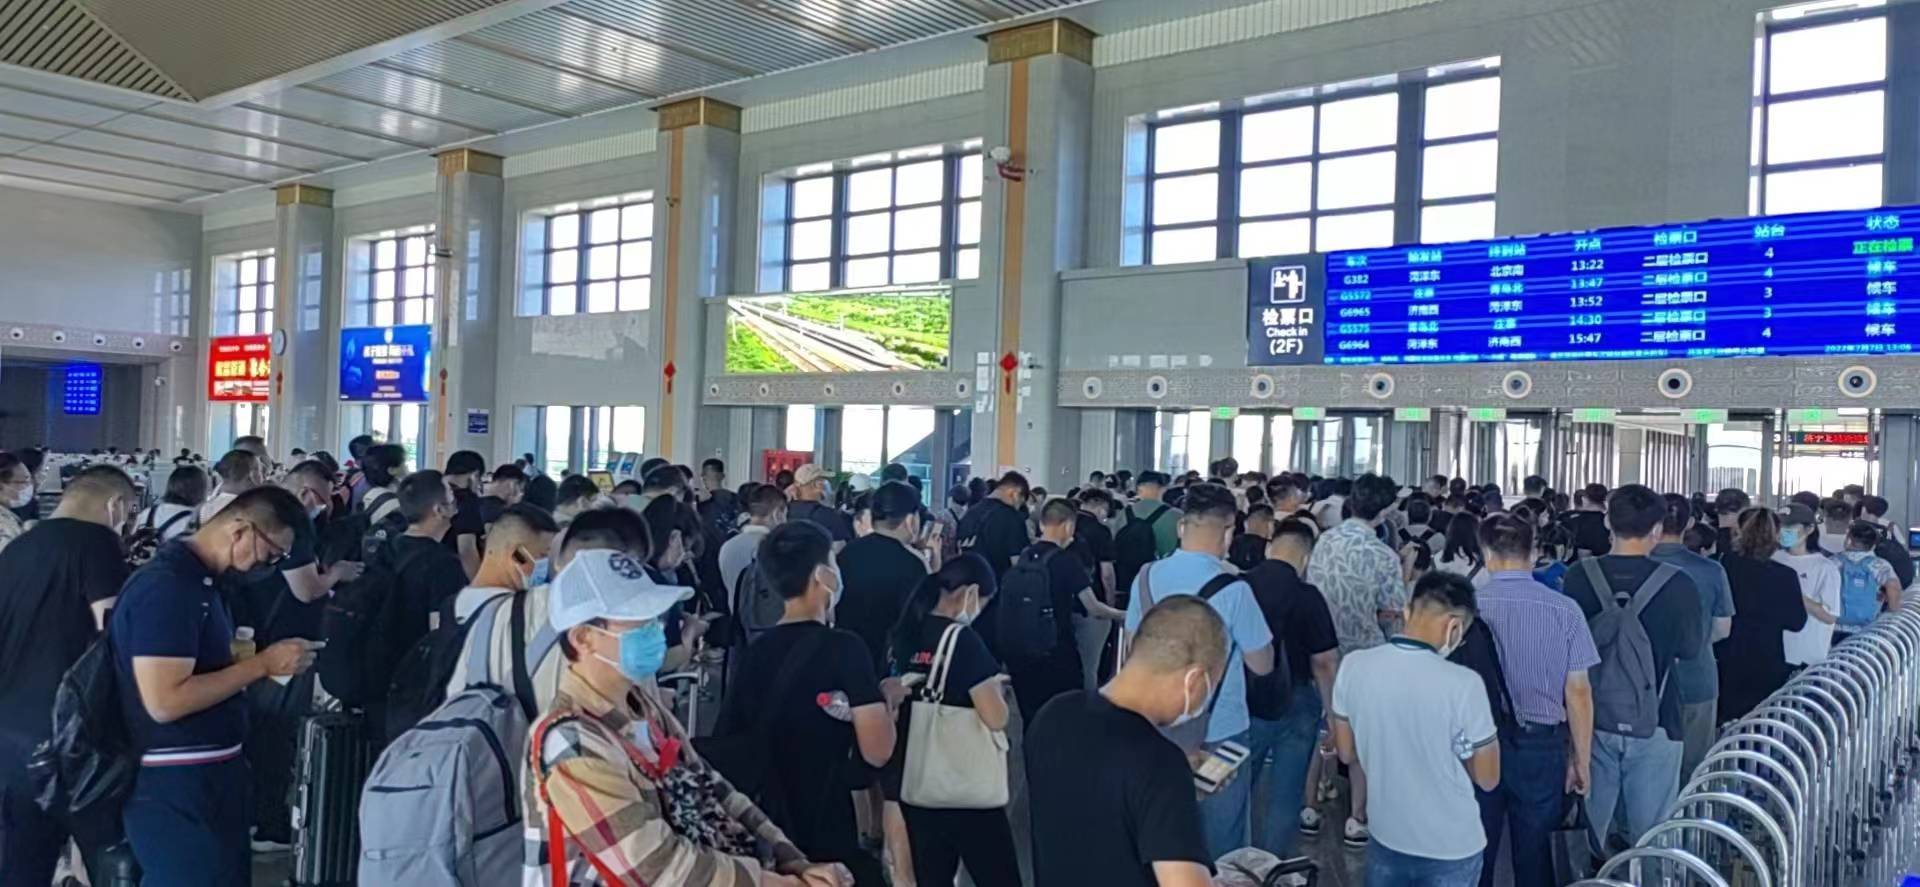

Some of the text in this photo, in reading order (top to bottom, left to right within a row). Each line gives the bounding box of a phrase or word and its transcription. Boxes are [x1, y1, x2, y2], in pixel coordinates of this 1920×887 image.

[1574, 238, 1601, 252] 开点
[1653, 230, 1697, 246] 检票口
[1754, 223, 1786, 239] 站台
[1866, 215, 1900, 230] 状态
[1343, 274, 1369, 285] G382
[1490, 264, 1524, 277] 北京南
[1571, 259, 1604, 271] 13:22
[1642, 252, 1709, 267] 二层检票口
[1764, 247, 1774, 258] 4
[1853, 238, 1914, 254] 正在检票
[1570, 277, 1603, 290] 13:47
[1641, 271, 1708, 286] 二层检票口
[1764, 267, 1773, 278] 4
[1866, 261, 1897, 274] 候车
[1339, 307, 1370, 317] G6965
[1408, 304, 1439, 316] 济南西
[1570, 296, 1603, 307] 13:52
[1641, 290, 1707, 305] 二层检票口
[1763, 287, 1773, 298] 3
[1866, 281, 1897, 295] 候车
[1262, 308, 1314, 326] 检票口
[1569, 315, 1602, 326] 14:30
[1640, 310, 1706, 324] 二层检票口
[1763, 307, 1772, 318] 3
[1866, 302, 1897, 316] 候车
[1266, 327, 1308, 338] Check in
[1338, 341, 1370, 350] G6964
[1488, 335, 1522, 347] 济南西
[1569, 333, 1601, 344] 15:47
[1640, 329, 1706, 343] 二层检票口
[1762, 327, 1771, 338] 4
[1865, 323, 1896, 337] 候车
[1269, 338, 1303, 355] (2F)
